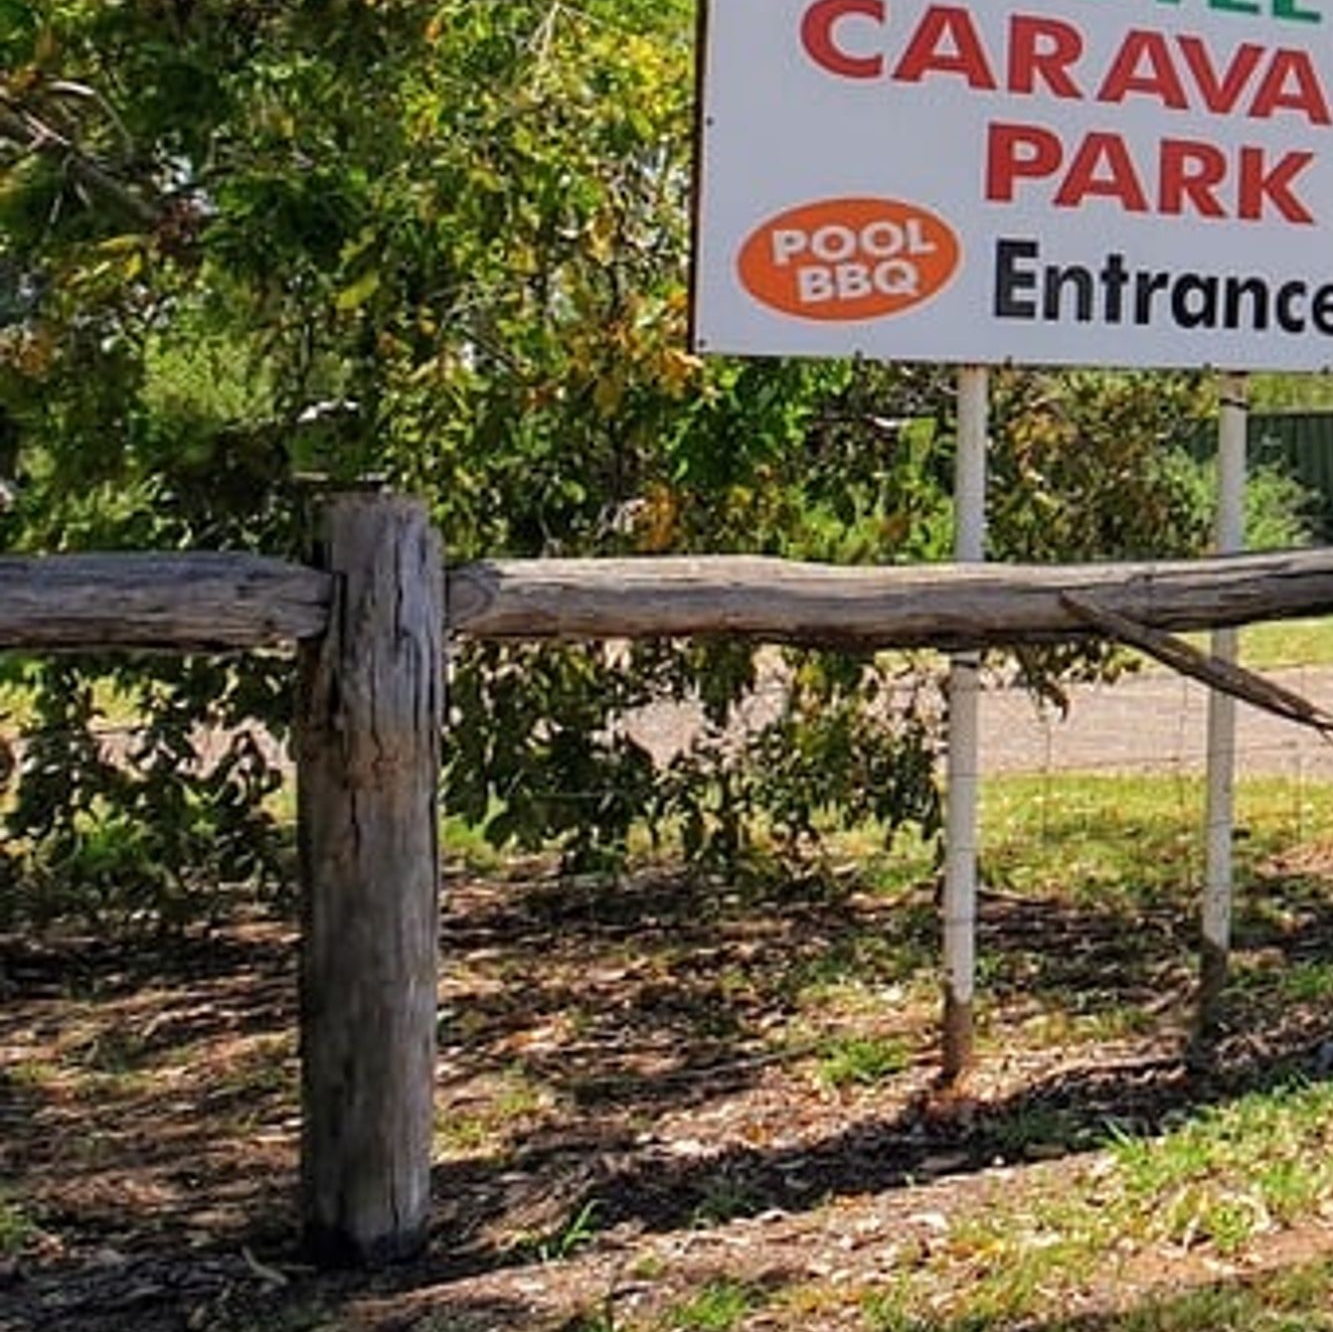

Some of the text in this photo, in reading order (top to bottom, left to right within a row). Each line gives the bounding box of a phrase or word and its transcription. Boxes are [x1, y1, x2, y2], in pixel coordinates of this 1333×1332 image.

[984, 121, 1313, 226] PARK
[772, 218, 938, 267] POOL
[795, 258, 921, 304] BBQ
